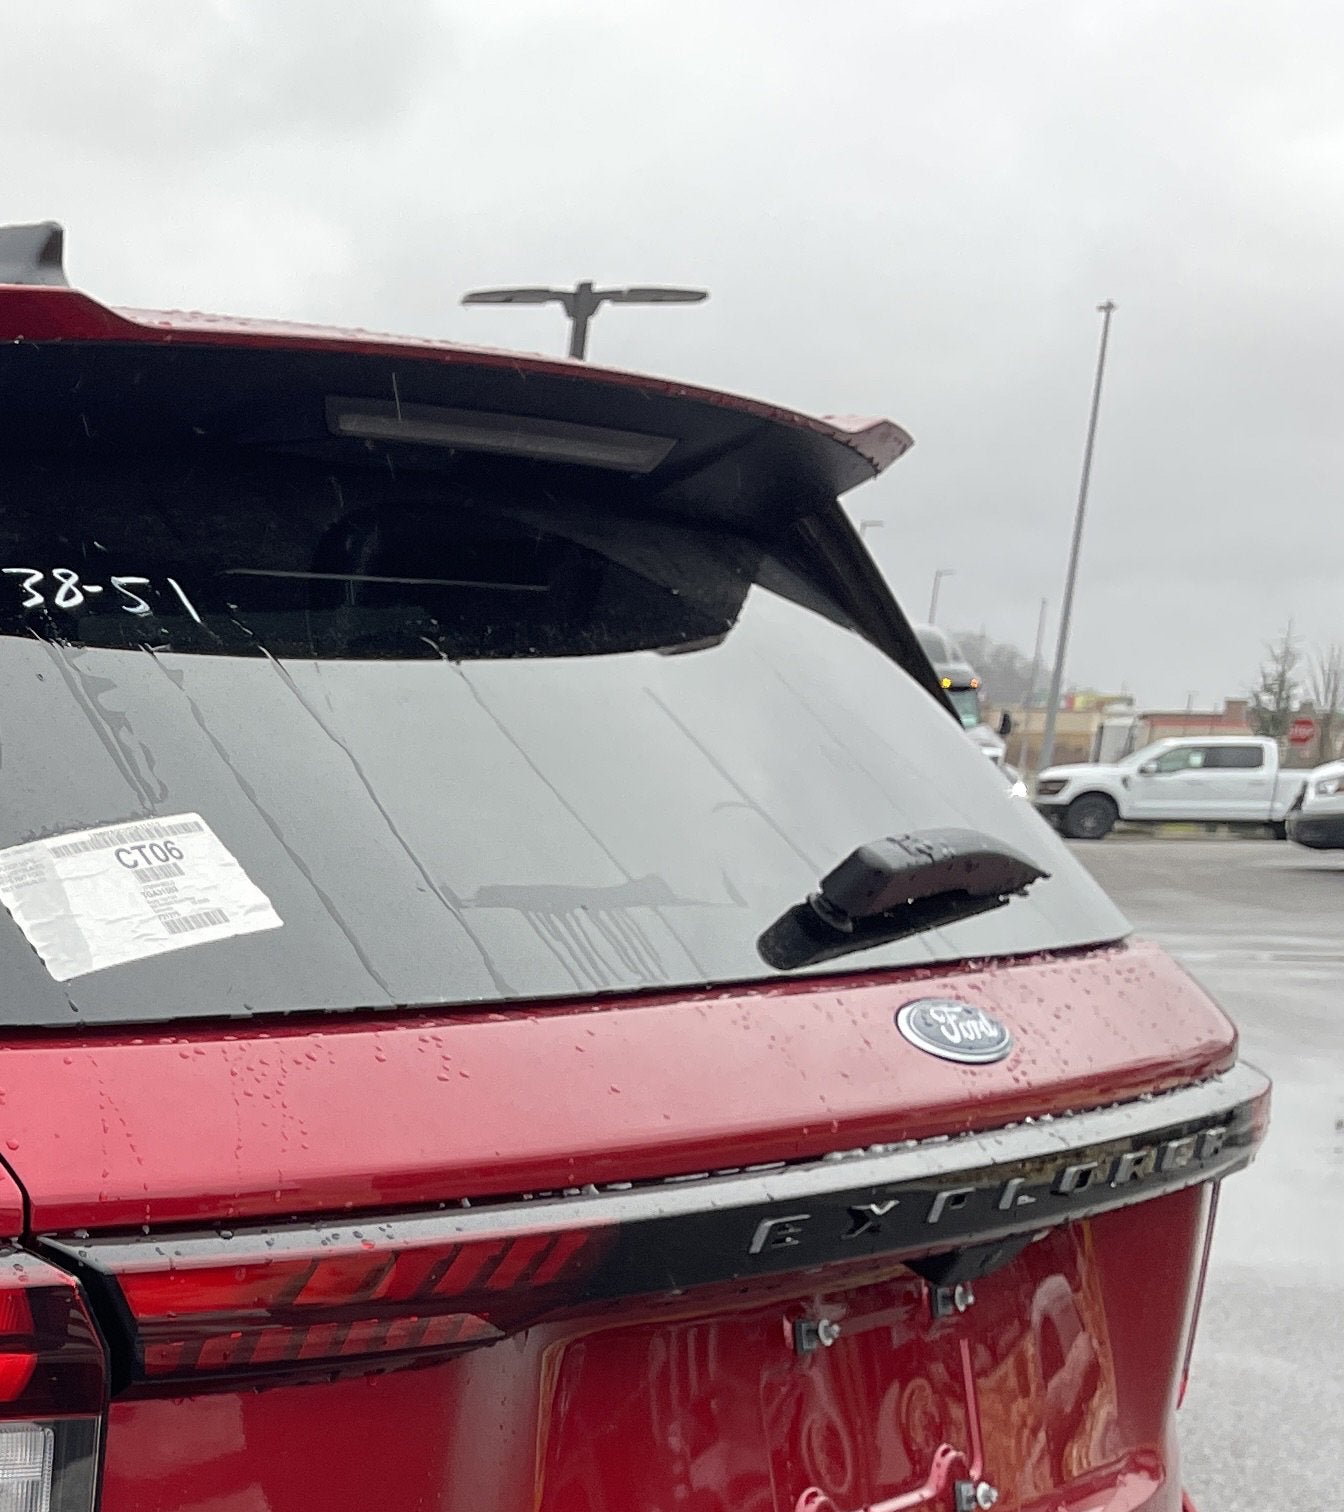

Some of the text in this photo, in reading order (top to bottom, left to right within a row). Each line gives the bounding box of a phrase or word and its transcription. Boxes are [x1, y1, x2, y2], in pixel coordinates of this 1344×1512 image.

[1, 567, 202, 624] 38-51
[114, 840, 185, 870] CT06
[929, 1005, 999, 1043] Ford
